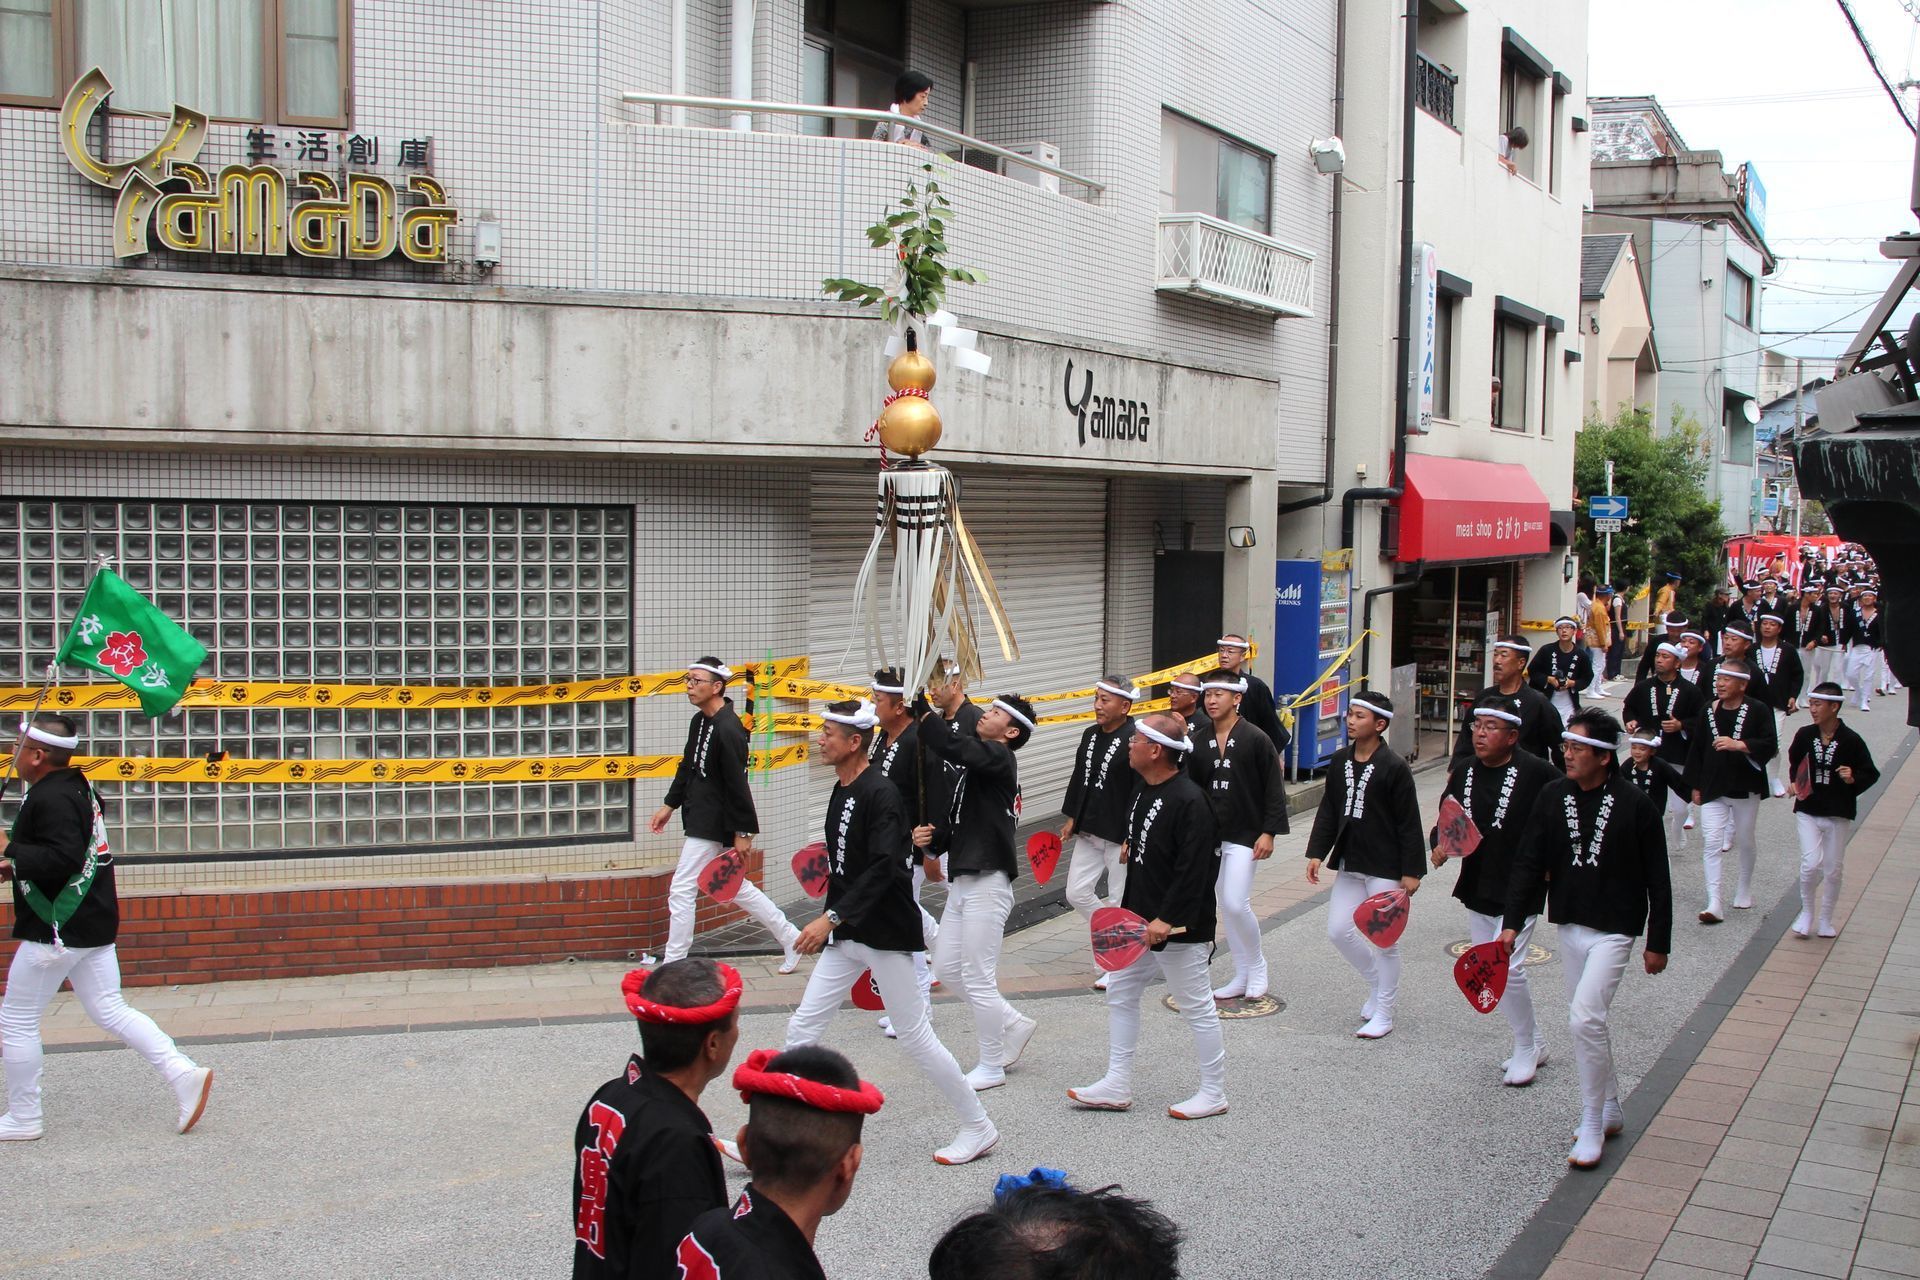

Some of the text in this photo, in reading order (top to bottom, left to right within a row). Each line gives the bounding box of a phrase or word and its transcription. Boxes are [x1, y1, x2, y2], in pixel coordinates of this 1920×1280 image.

[1456, 522, 1473, 537] meat
[1476, 520, 1492, 538] shop
[1496, 517, 1520, 540] おがわ
[1491, 766, 1518, 829] 大北町世話人
[1586, 794, 1615, 867] 大北町世話人
[835, 797, 856, 876] 大北町世話人
